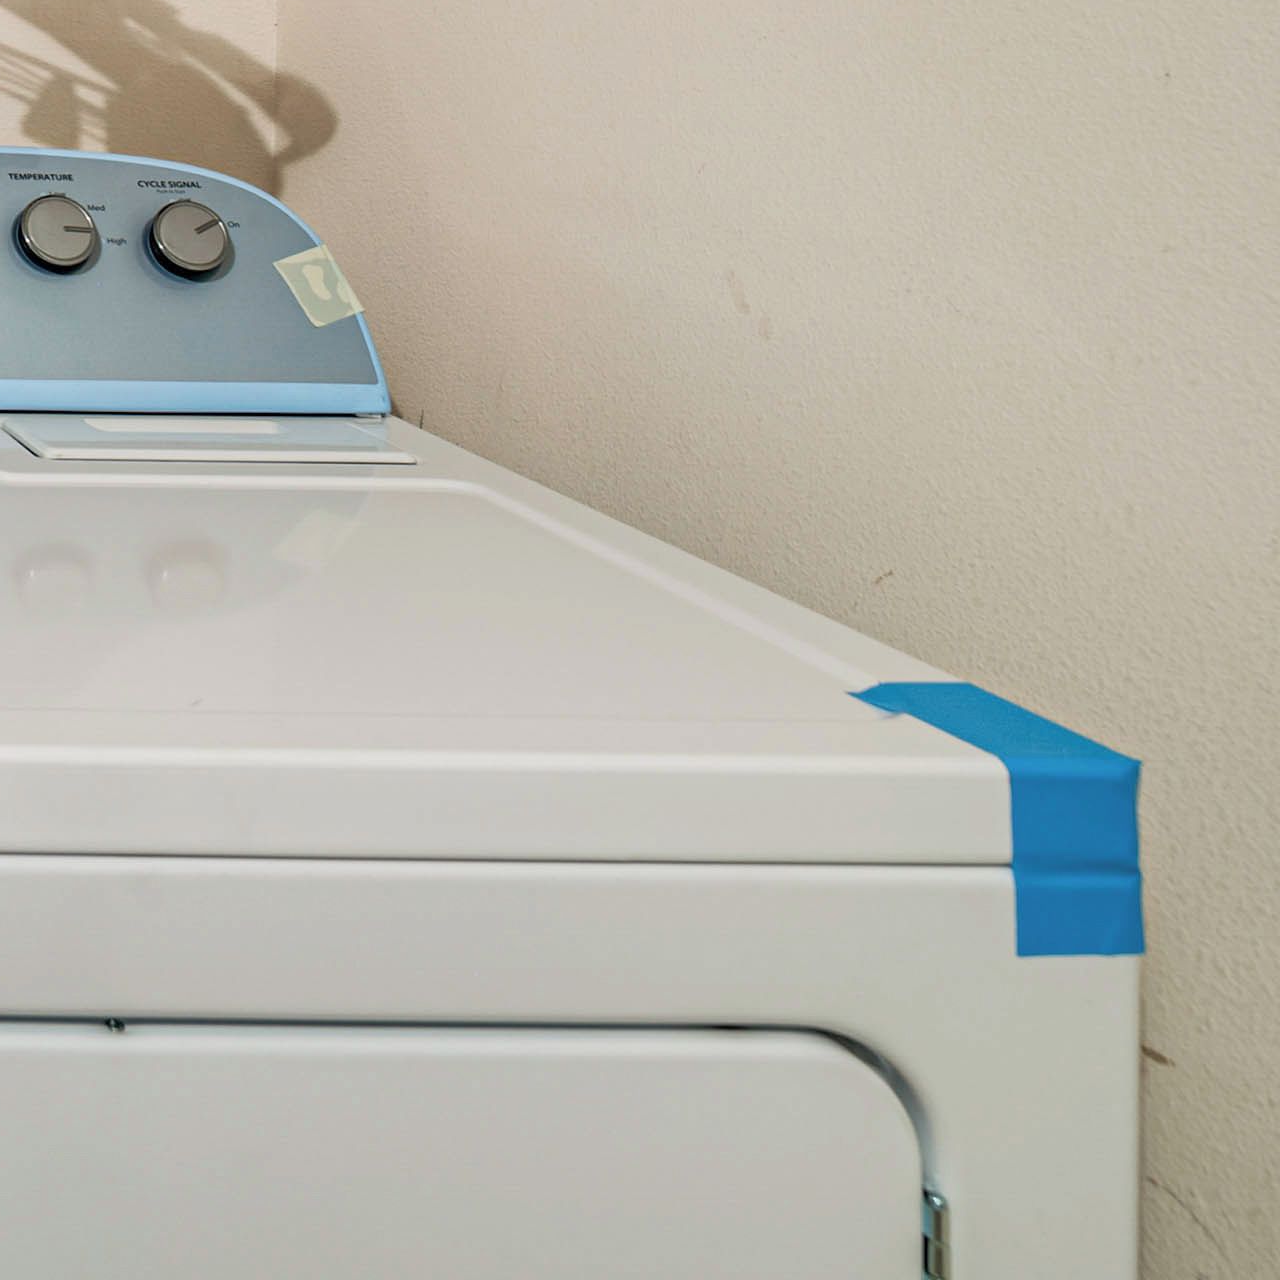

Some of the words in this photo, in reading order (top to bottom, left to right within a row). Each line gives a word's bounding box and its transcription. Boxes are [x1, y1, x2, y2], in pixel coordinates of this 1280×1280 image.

[8, 172, 74, 182] TEMPERATURE
[137, 180, 167, 189] CYCLE
[168, 180, 202, 189] SIGNAL
[87, 204, 106, 212] Med
[107, 237, 127, 246] High
